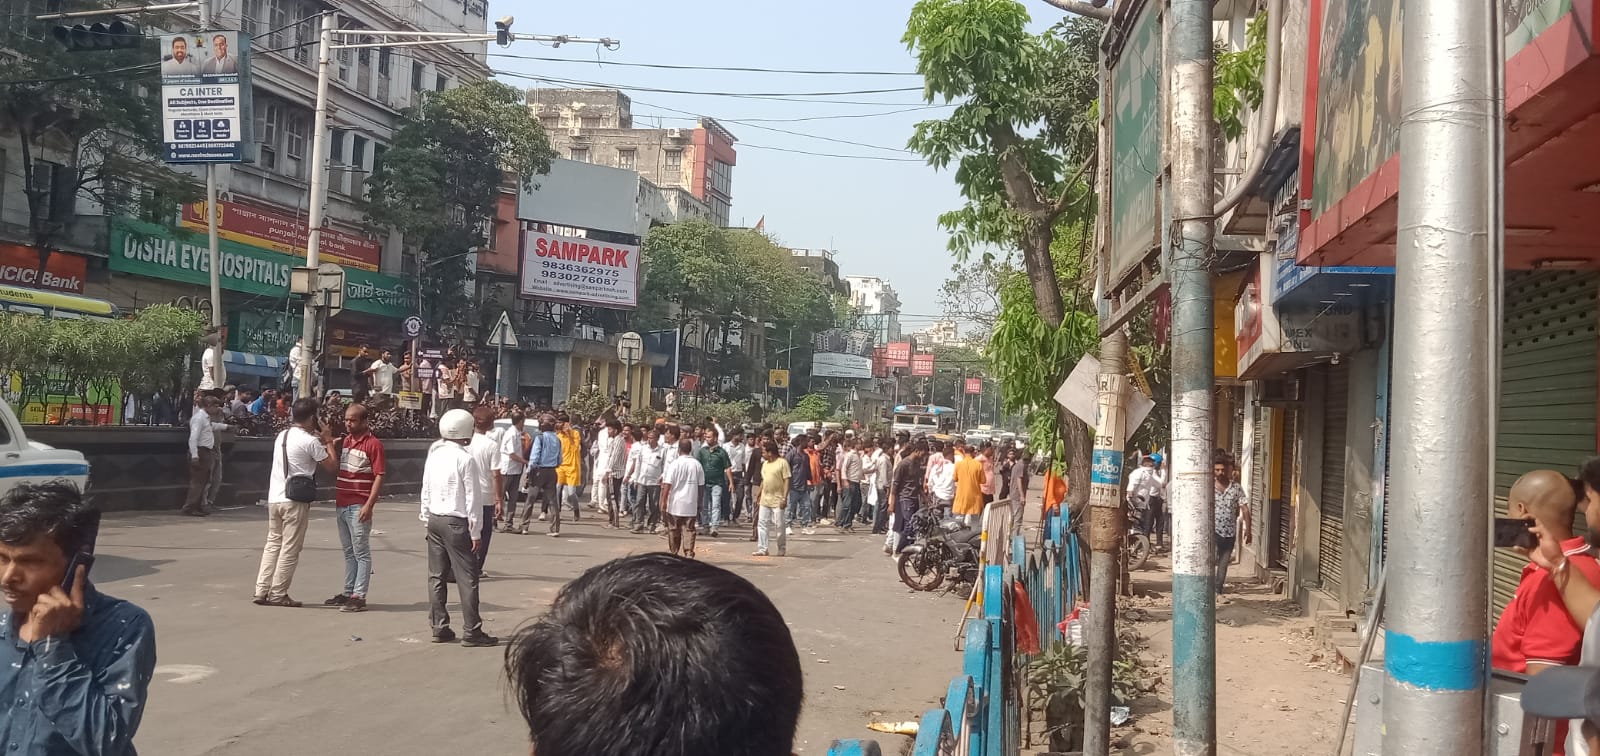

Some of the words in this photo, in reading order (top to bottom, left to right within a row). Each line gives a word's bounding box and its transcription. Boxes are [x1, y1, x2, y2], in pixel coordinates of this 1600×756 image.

[180, 88, 194, 97] CA
[196, 87, 222, 96] INTER
[124, 232, 177, 268] DISHA
[181, 243, 210, 273] EYE
[329, 241, 346, 251] bank
[535, 237, 630, 269] SAMPARK
[541, 270, 619, 286] 9830276087
[542, 260, 620, 278] 9836362975
[41, 270, 81, 290] Bank
